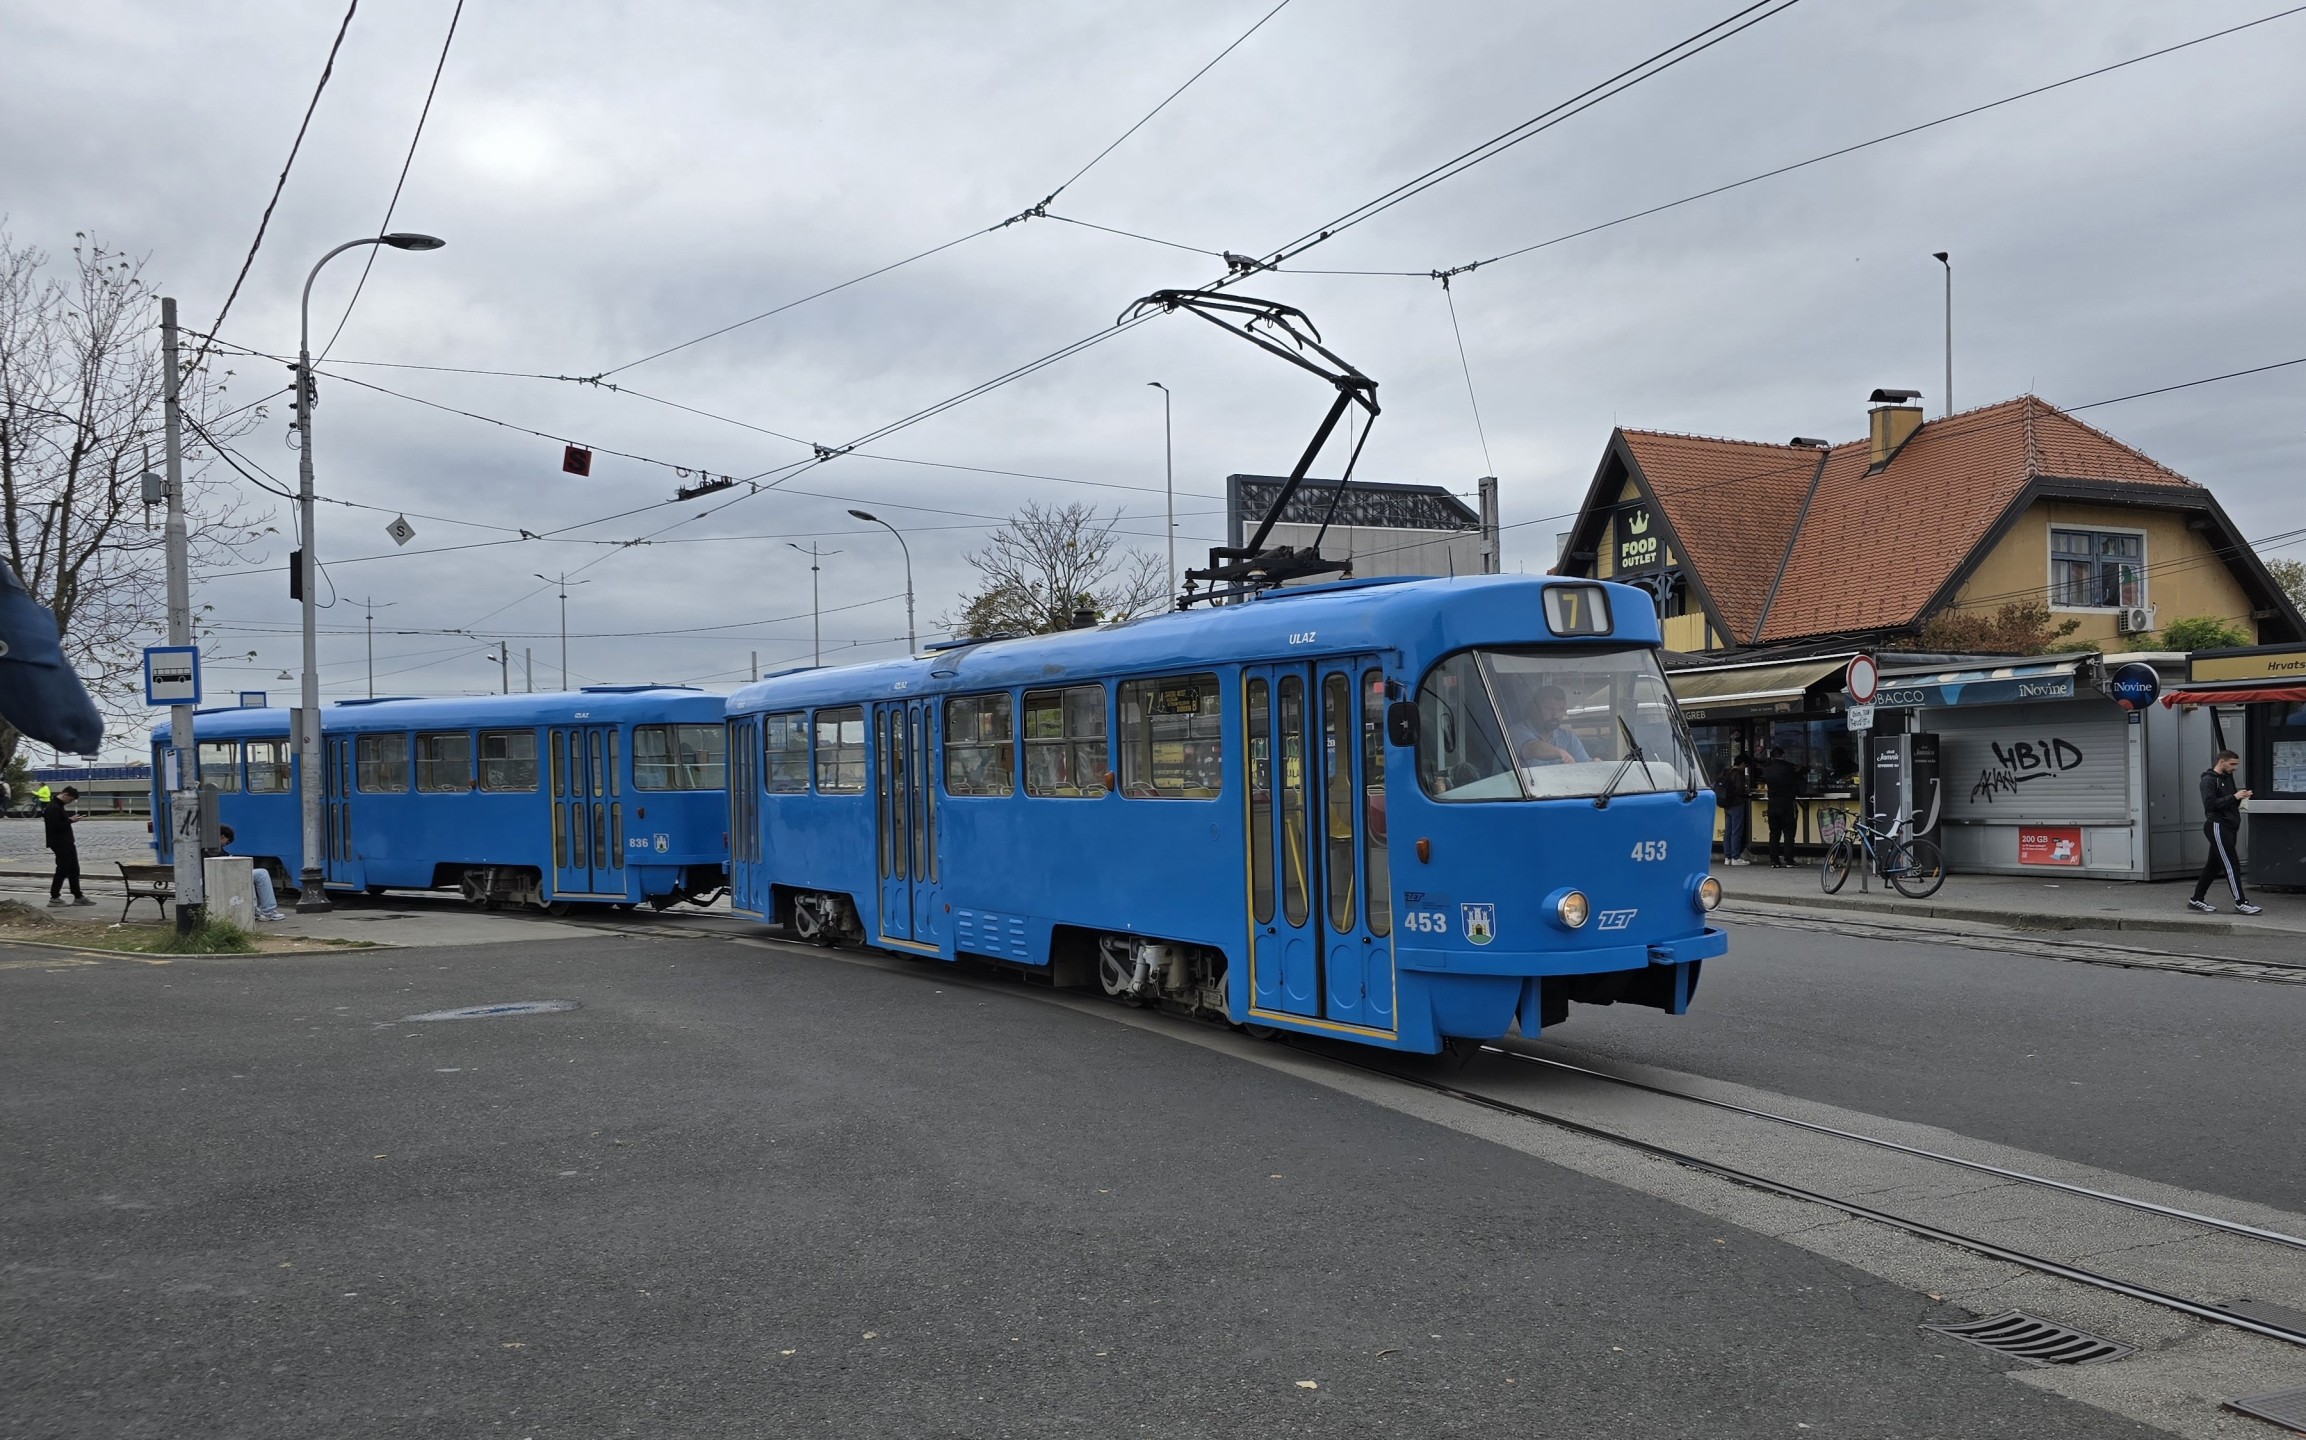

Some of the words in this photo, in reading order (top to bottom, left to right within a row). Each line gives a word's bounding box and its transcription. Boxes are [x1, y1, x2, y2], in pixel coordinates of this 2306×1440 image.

[396, 525, 406, 538] S
[1622, 537, 1657, 557] FOOD
[1622, 552, 1657, 568] OUTLET
[1562, 593, 1578, 629] 7
[1289, 631, 1317, 645] ULAZ
[2267, 660, 2306, 671] Hrvats
[2019, 682, 2067, 697] iNovine
[2113, 681, 2152, 692] iNovine
[1866, 690, 1925, 705] OBACCO
[629, 838, 649, 848] 836
[2022, 835, 2035, 843] 200
[2036, 835, 2049, 843] GB
[1630, 840, 1667, 862] 453
[1404, 891, 1426, 902] ZET
[1404, 911, 1447, 933] 453
[1598, 908, 1639, 930] ZET
